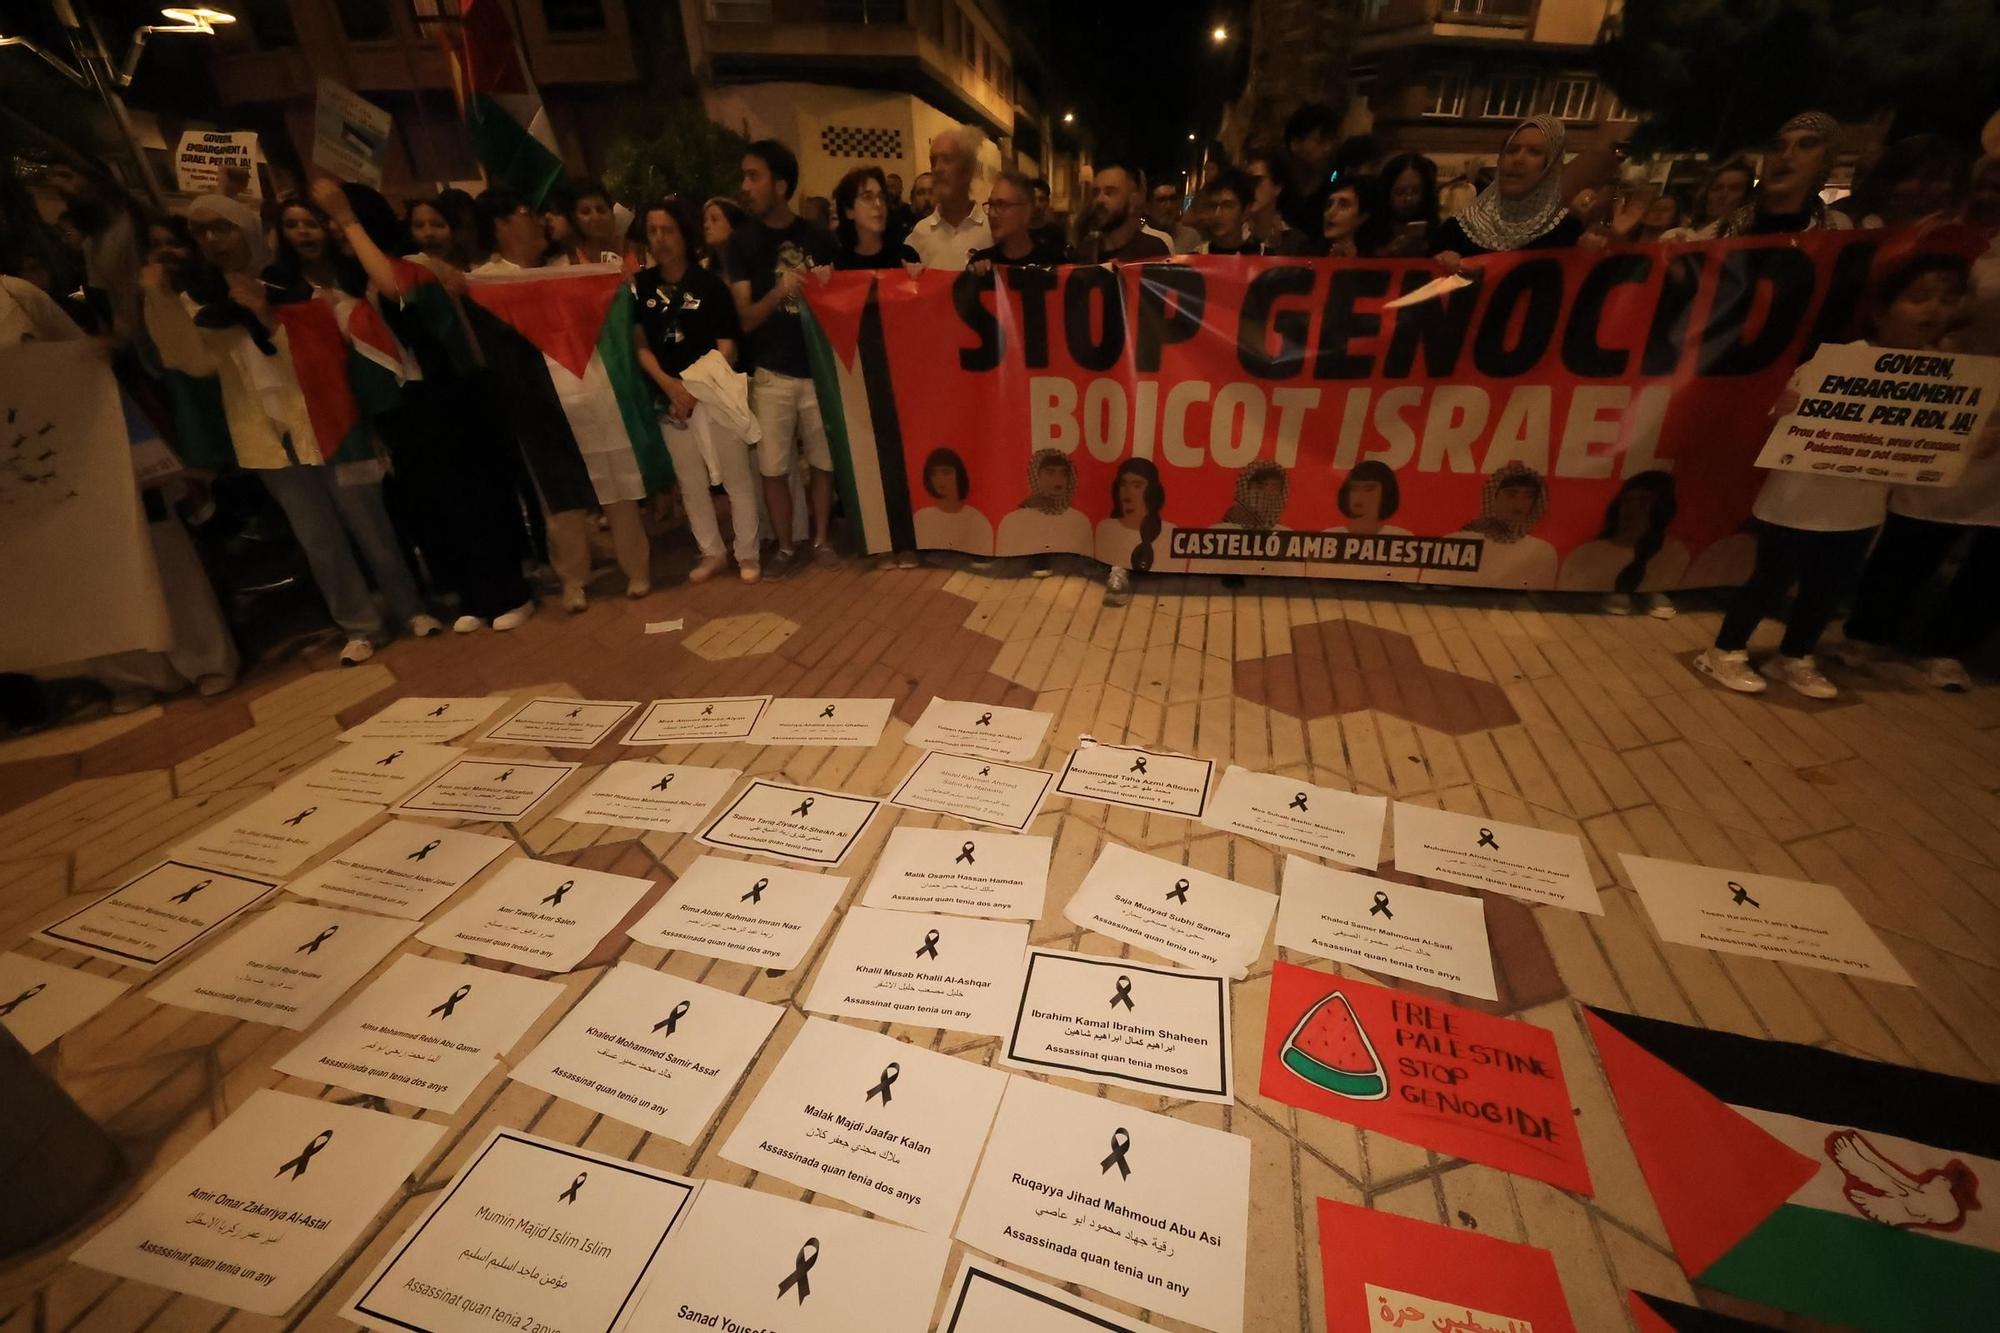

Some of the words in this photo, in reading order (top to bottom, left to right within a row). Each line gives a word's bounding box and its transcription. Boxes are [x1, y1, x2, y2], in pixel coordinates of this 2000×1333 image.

[181, 154, 206, 164] ISRAEL
[242, 146, 248, 155] A
[952, 262, 1206, 371] STOP
[1874, 353, 1955, 379] GOVERN,
[1819, 375, 1968, 404] EMBARGAMENT
[1965, 387, 1982, 407] A
[1029, 376, 1322, 469] BOICOT
[1331, 384, 1674, 481] ISRAEL
[1797, 398, 1866, 423] ISRAEL
[1868, 405, 1909, 426] PER
[1949, 412, 1978, 434] JA!
[1788, 425, 1813, 438] Prou
[1815, 428, 1830, 439] de
[1804, 441, 1853, 457] Palestina
[1855, 448, 1869, 458] no
[1172, 532, 1281, 557] CASTELLÓ
[1286, 536, 1338, 559] AMB
[1343, 539, 1477, 567] PALESTINA
[1070, 767, 1119, 779] Mohammed
[1122, 775, 1140, 783] Taha
[1142, 779, 1164, 787] Azmi
[1165, 783, 1199, 793] Alloush
[957, 874, 987, 883] Hassan
[989, 878, 1023, 886] Hamdan
[891, 894, 933, 902] Assassinat
[1114, 894, 1132, 905] Saja
[1134, 902, 1168, 917] Muayad
[1169, 914, 1195, 926] Subhi
[1196, 923, 1231, 939] Samara
[1093, 913, 1142, 936] Assassinada
[1144, 933, 1164, 944] quan
[1166, 940, 1187, 952] tenia
[1201, 954, 1217, 963] any
[856, 965, 882, 975] Khalil
[883, 969, 914, 978] Musab
[916, 973, 943, 982] Khalil
[944, 976, 991, 988] Al-Ashqar
[843, 996, 892, 1008] Assassinat
[893, 1003, 915, 1011] quan
[917, 1005, 939, 1013] tenia
[954, 1011, 972, 1019] any
[1392, 999, 1461, 1036] FREE
[378, 1026, 420, 1040] Mohammed
[439, 1039, 456, 1048] Abu
[455, 1043, 481, 1053] Qamar
[1031, 1009, 1072, 1023] Ibrahim
[1075, 1016, 1109, 1028] Kamal
[1113, 1021, 1155, 1037] Ibrahim
[1158, 1030, 1208, 1046] Shaheen
[1064, 1028, 1091, 1037] شاهين
[585, 1027, 617, 1042] Khaled
[615, 1036, 666, 1059] Mohammed
[665, 1053, 692, 1068] Samir
[691, 1063, 720, 1077] Assaf
[1045, 1044, 1098, 1059] Assassinat
[1101, 1054, 1125, 1063] quan
[1128, 1058, 1152, 1069] tenia
[1155, 1064, 1188, 1075] mesos
[1396, 1028, 1554, 1079] PALESTINE
[318, 1056, 369, 1073] Assassinada
[367, 1067, 390, 1080] quan
[389, 1069, 411, 1085] tenia
[411, 1076, 427, 1089] dos
[427, 1083, 448, 1093] anys
[1399, 1057, 1469, 1086] STOP
[552, 1067, 596, 1088] Assassinat
[595, 1084, 617, 1096] quan
[617, 1091, 638, 1104] tenia
[638, 1099, 651, 1108] un
[650, 1104, 668, 1116] any
[804, 1104, 834, 1122] Malak
[835, 1115, 865, 1131] Majdi
[865, 1125, 899, 1142] Jaafar
[900, 1136, 931, 1155] Kalan
[758, 1141, 820, 1168] Assassinada
[821, 1164, 846, 1177] quan
[847, 1170, 873, 1186] tenia
[874, 1181, 894, 1195] dos
[896, 1190, 921, 1205] anys
[188, 1188, 216, 1202] Amir
[214, 1194, 245, 1209] Omar
[242, 1201, 288, 1221] Zakariya
[285, 1212, 332, 1230] Al-Astal
[1012, 1173, 1063, 1197] Ruqayya
[1066, 1190, 1101, 1208] Jihad
[1104, 1199, 1166, 1230] Mahmoud
[1169, 1222, 1196, 1239] Abu
[1199, 1231, 1221, 1247] Asi
[1035, 1208, 1067, 1219] عاصي
[1073, 1215, 1086, 1227] ابو
[474, 1206, 515, 1228] Mumin
[514, 1218, 551, 1239] Majid
[547, 1228, 579, 1248] Islim
[579, 1238, 612, 1258] Islim
[1089, 1220, 1121, 1236] محمود
[1125, 1230, 1148, 1247] جهاد
[136, 1240, 193, 1262] Assassinat
[189, 1256, 216, 1269] quan
[215, 1261, 241, 1275] tenia
[240, 1268, 256, 1279] un
[254, 1273, 276, 1287] any
[458, 1247, 486, 1261] اسليم
[485, 1257, 520, 1271] اسليم
[1003, 1226, 1077, 1257] Assassinada
[1080, 1251, 1110, 1268] quan
[1114, 1260, 1143, 1280] tenia
[1147, 1274, 1163, 1287] un
[1166, 1281, 1189, 1297] any
[516, 1266, 540, 1279] ماجد
[402, 1277, 463, 1306] Assassinat
[461, 1299, 491, 1316] quan
[491, 1307, 522, 1327] tenia
[521, 1317, 533, 1331] 2
[677, 1304, 719, 1327] Sanad
[1378, 1295, 1425, 1328] حرة
